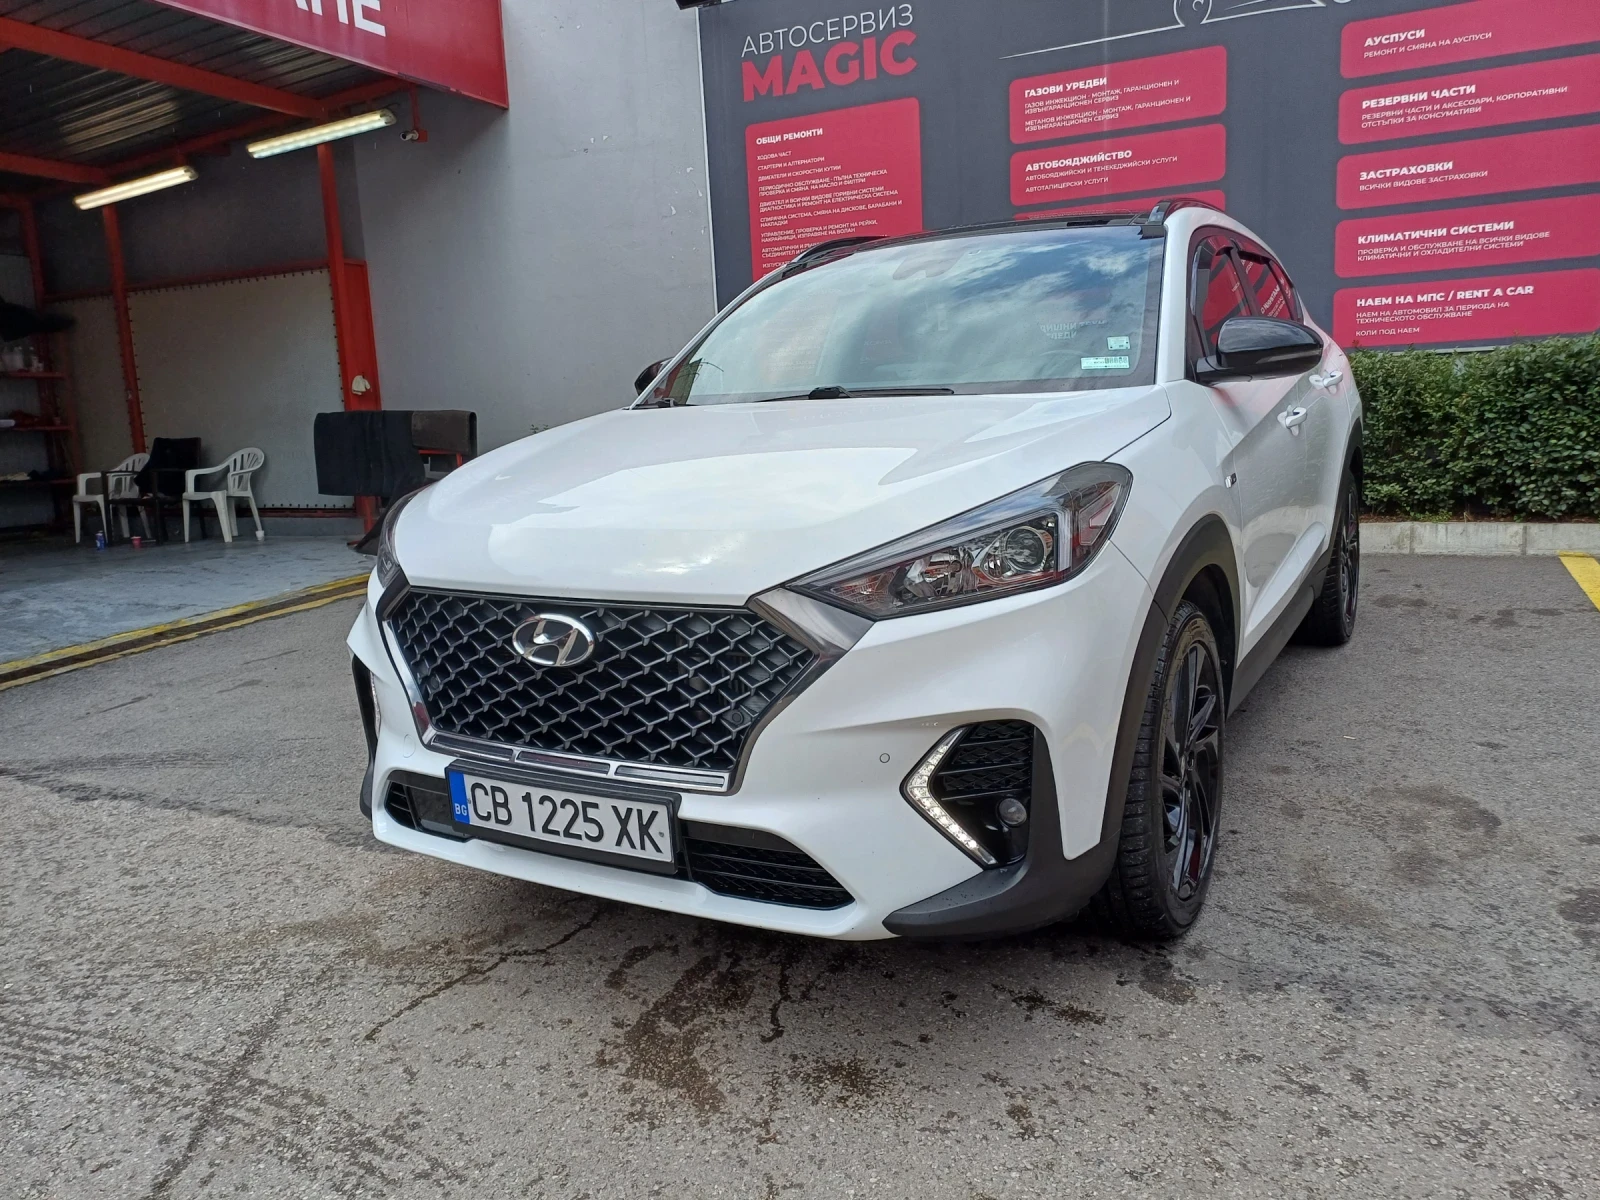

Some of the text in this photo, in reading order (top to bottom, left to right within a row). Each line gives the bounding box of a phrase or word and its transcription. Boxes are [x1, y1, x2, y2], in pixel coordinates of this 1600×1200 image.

[742, 4, 913, 57] АВТОСЕРВИЗ
[1364, 29, 1425, 47] АУСПУСИ
[1364, 47, 1397, 58] РЕМОНТ
[1407, 42, 1436, 52] СМЯНА
[1452, 32, 1492, 44] АУСПУСИ
[742, 30, 917, 102] MAGIC
[1025, 77, 1107, 98] ГАЗОВИ УРЕДБИ
[1045, 94, 1086, 105] ИНЖЕКЦИОН
[1092, 89, 1122, 98] МОНТАЖ,
[1124, 81, 1172, 93] ГАРАНЦИОНЕН
[1362, 84, 1475, 109] РЕЗЕРВНИ ЧАСТИ
[1025, 99, 1092, 114] ИЗВЪНГАРАНЦИОНЕН
[1025, 117, 1054, 126] МЕТАНОВ
[1056, 111, 1097, 121] ИНЖЕКЦИОН
[1103, 105, 1133, 114] МОНТАЖ,
[1135, 97, 1184, 109] ГАРАНЦИОНЕН
[1362, 109, 1403, 120] РЕЗЕРВНИ
[1405, 105, 1432, 114] ЧАСТИ
[1442, 96, 1494, 109] АКСЕСОАРИ,
[1496, 86, 1568, 101] КОРПОРАТИВНИ
[1025, 113, 1118, 132] ИЗВЪНГАРАНЦИОНЕН СЕРВИЗ
[1362, 117, 1404, 128] ОТСТЪПКИ
[1419, 106, 1481, 120] КОНСУМАТИВИ
[756, 128, 822, 145] ОБЩИ РЕМОНТИ
[1025, 150, 1132, 171] АВТОБОЯДЖИЙСТВО
[1025, 168, 1086, 181] АВТОБОЯДЖИЙСКИ
[1094, 160, 1150, 172] ТЕНЕКЕДЖИЙСКИ
[1152, 156, 1178, 165] УСЛУГИ
[1360, 161, 1453, 180] ЗАСТРАХОВКИ
[1025, 177, 1108, 193] АВТОТАПИЦЕРСКИ УСЛУГИ
[1360, 171, 1488, 191] ВСИЧКИ ВИДОВЕ ЗАСТРАХОВКИ
[1358, 221, 1514, 244] КЛИМАТИЧНИ СИСТЕМИ
[1358, 247, 1398, 255] ПРОВЕРКА
[1408, 240, 1463, 251] ОБСЛУЖВАНЕ
[1479, 236, 1512, 244] ВСИЧКИ
[1515, 231, 1550, 240] ВИДОВЕ
[1358, 252, 1411, 261] КЛИМАТИЧНИ
[1421, 246, 1481, 255] ОХЛАДИТЕЛНИ
[1483, 241, 1523, 250] СИСТЕМИ
[1357, 286, 1534, 307] НАЕМ НА МПС / RENT A CAR
[1357, 311, 1472, 324] ТЕХНИЧЕСКОТО ОБСЛУЖВАНЕ
[1392, 307, 1442, 315] АВТОМОБИЛ
[455, 803, 468, 816] BG
[522, 792, 604, 843] 1225
